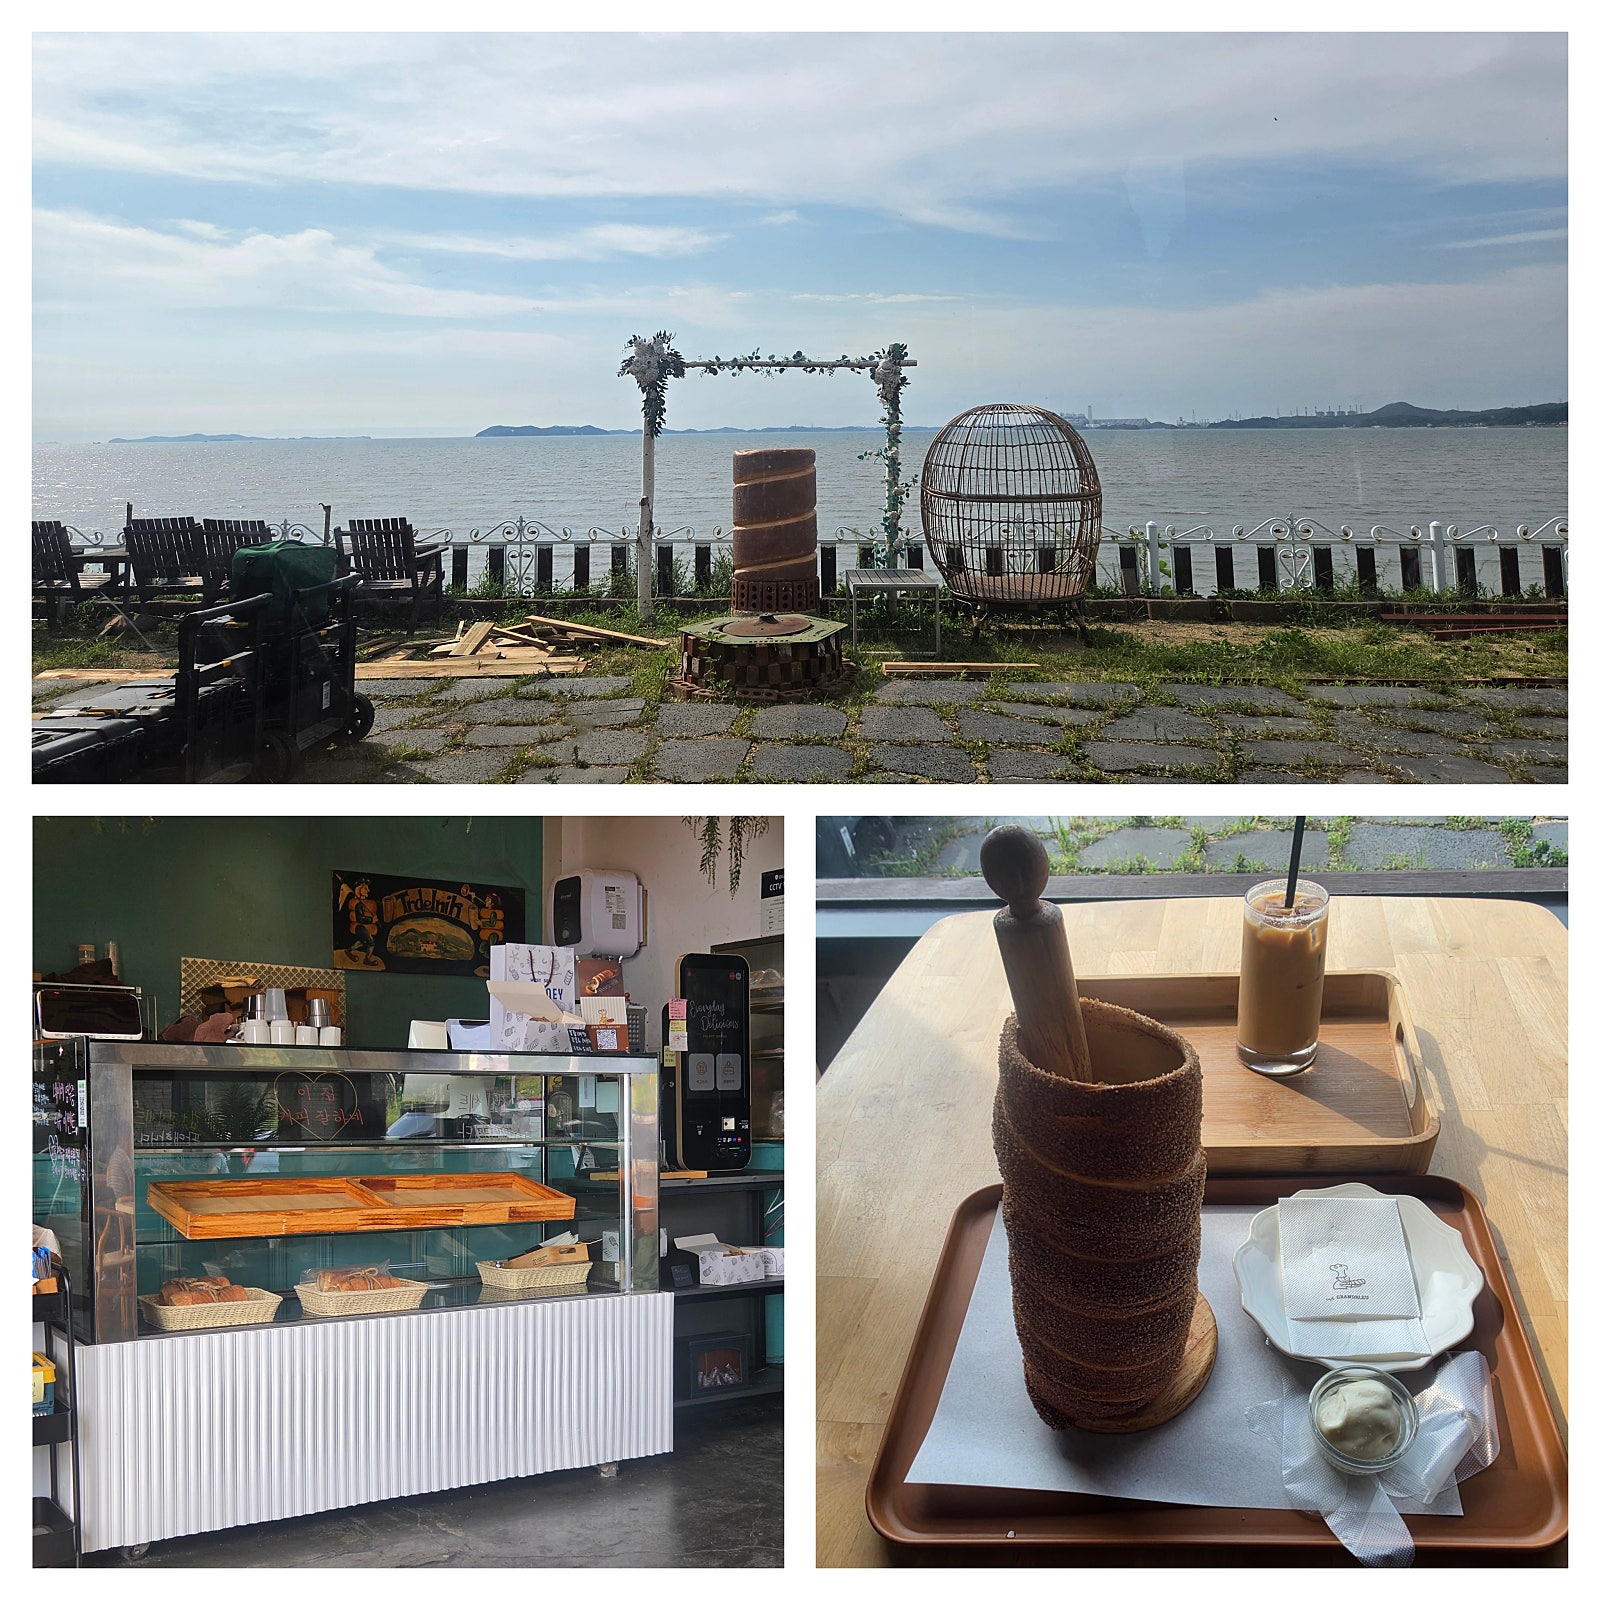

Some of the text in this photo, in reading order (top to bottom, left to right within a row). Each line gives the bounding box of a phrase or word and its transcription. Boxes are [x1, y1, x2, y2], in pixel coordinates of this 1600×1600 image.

[769, 882, 783, 891] CCTV
[297, 1084, 311, 1101] 이
[278, 1108, 310, 1126] 커피
